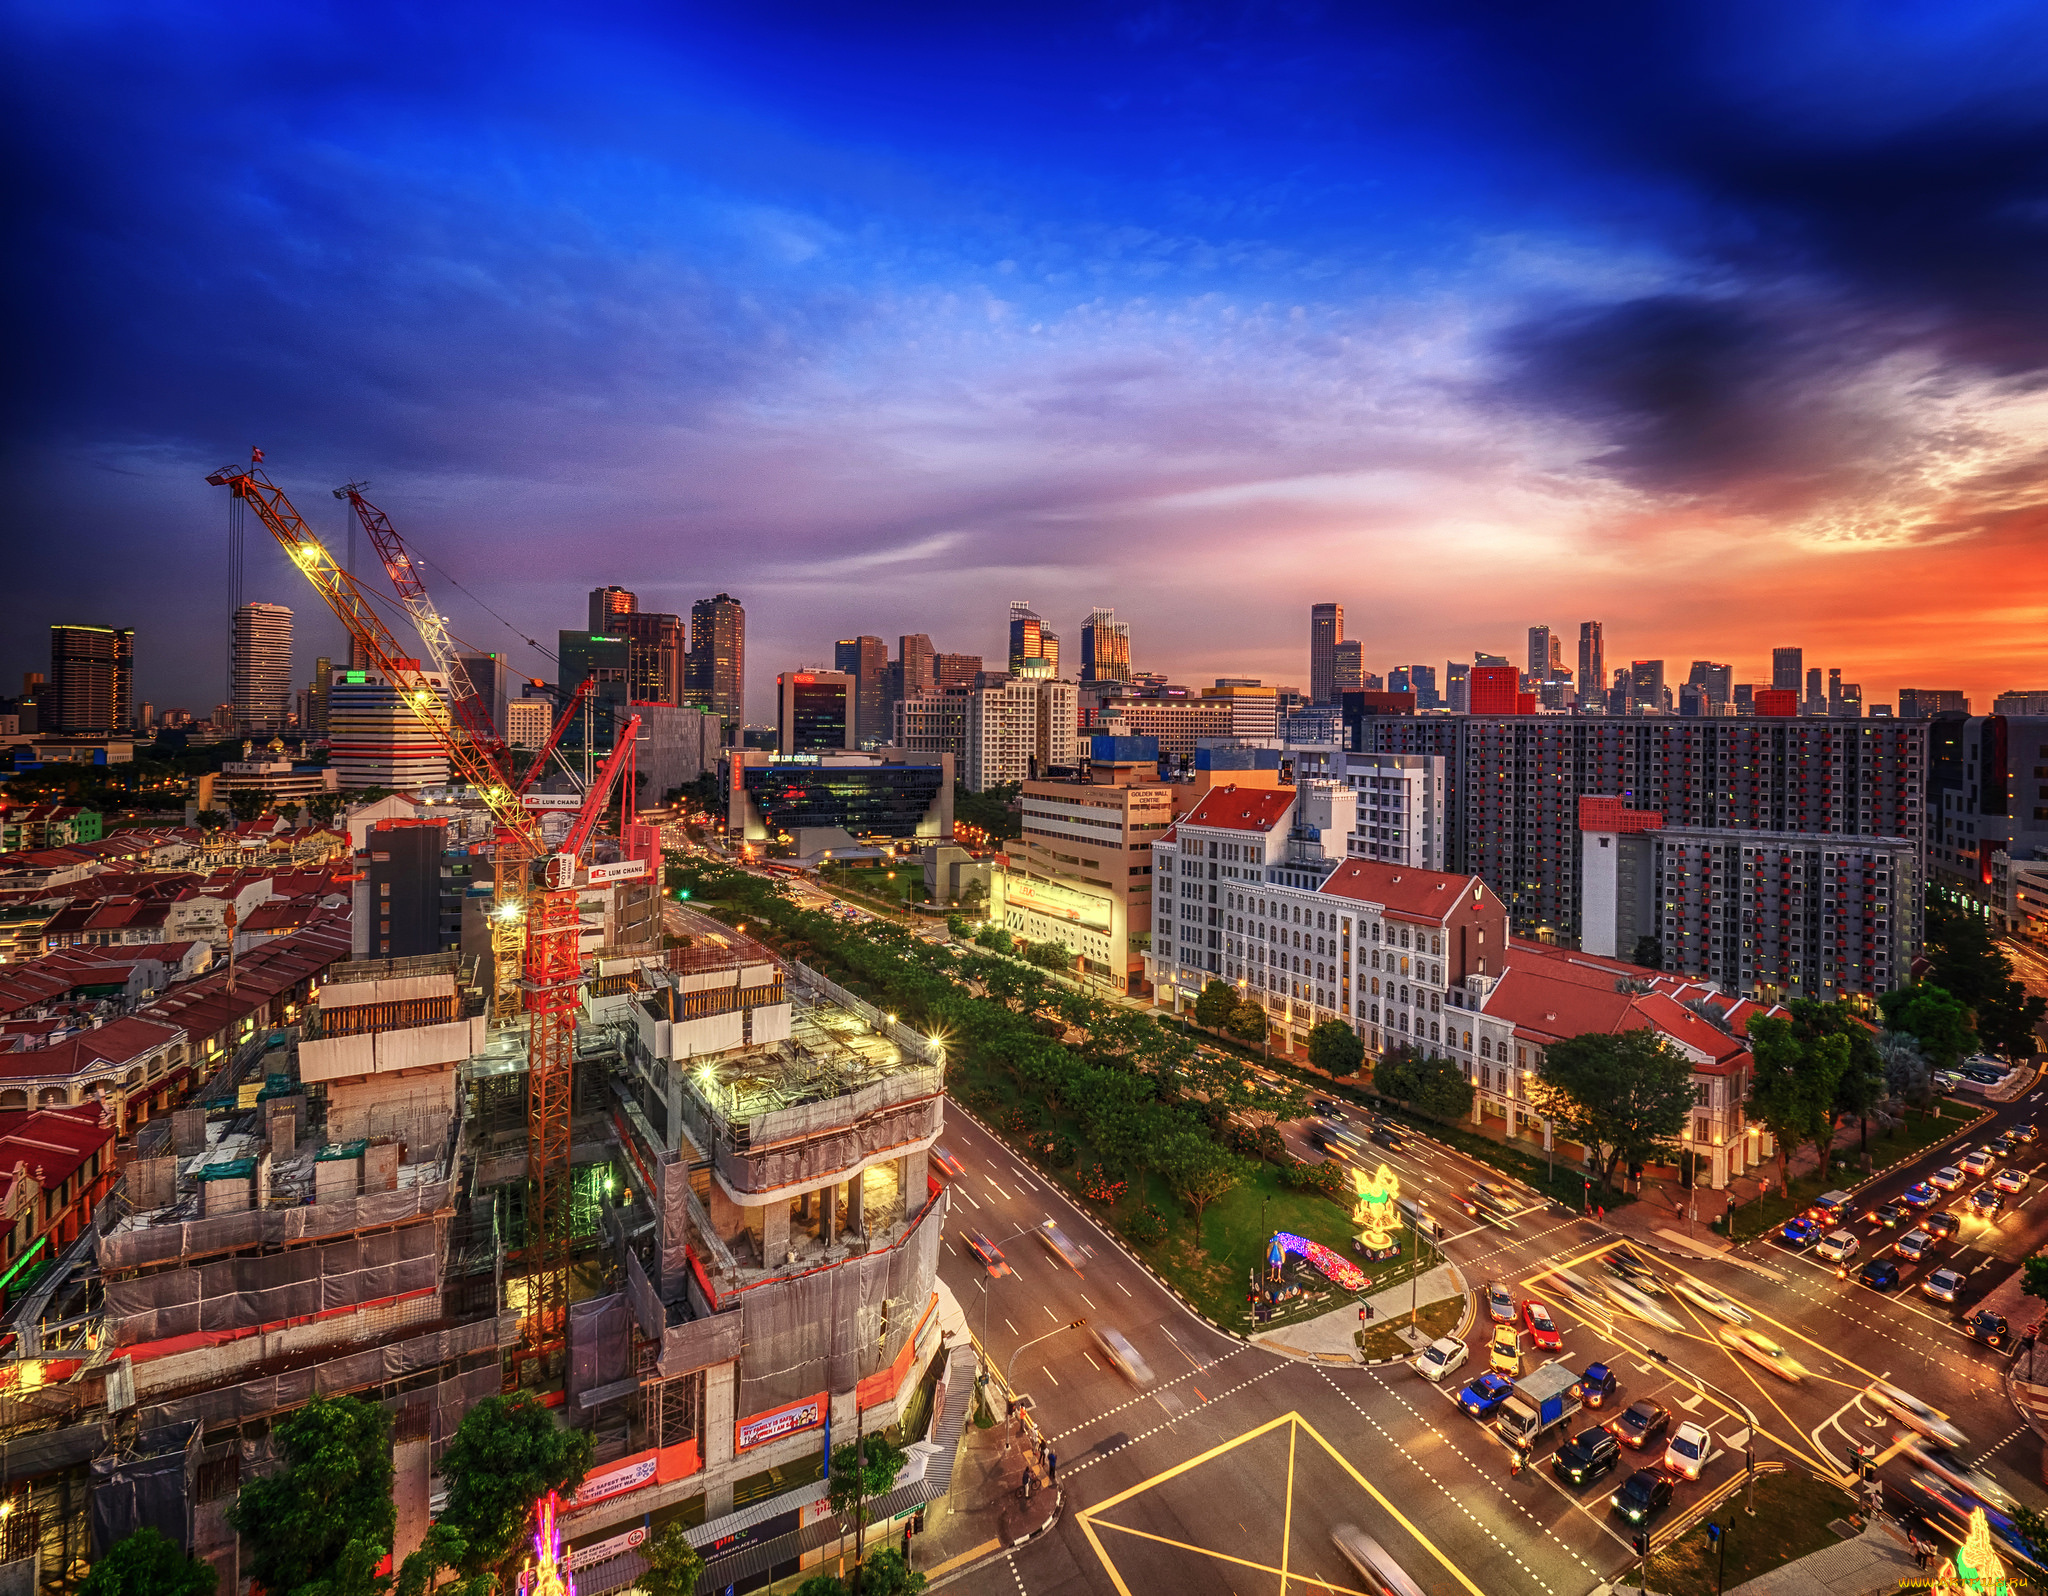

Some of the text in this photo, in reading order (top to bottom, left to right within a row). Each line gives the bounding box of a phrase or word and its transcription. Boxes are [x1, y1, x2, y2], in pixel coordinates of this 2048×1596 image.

[623, 866, 643, 875] CHANG
[1019, 886, 1035, 897] LEVO
[753, 1422, 771, 1433] FAMILY
[596, 1478, 619, 1490] SAFEST
[620, 1473, 633, 1482] WAY
[591, 1490, 602, 1498] THE
[604, 1483, 622, 1492] RIGHT
[624, 1478, 637, 1486] WAY
[589, 1543, 606, 1553] CHANG
